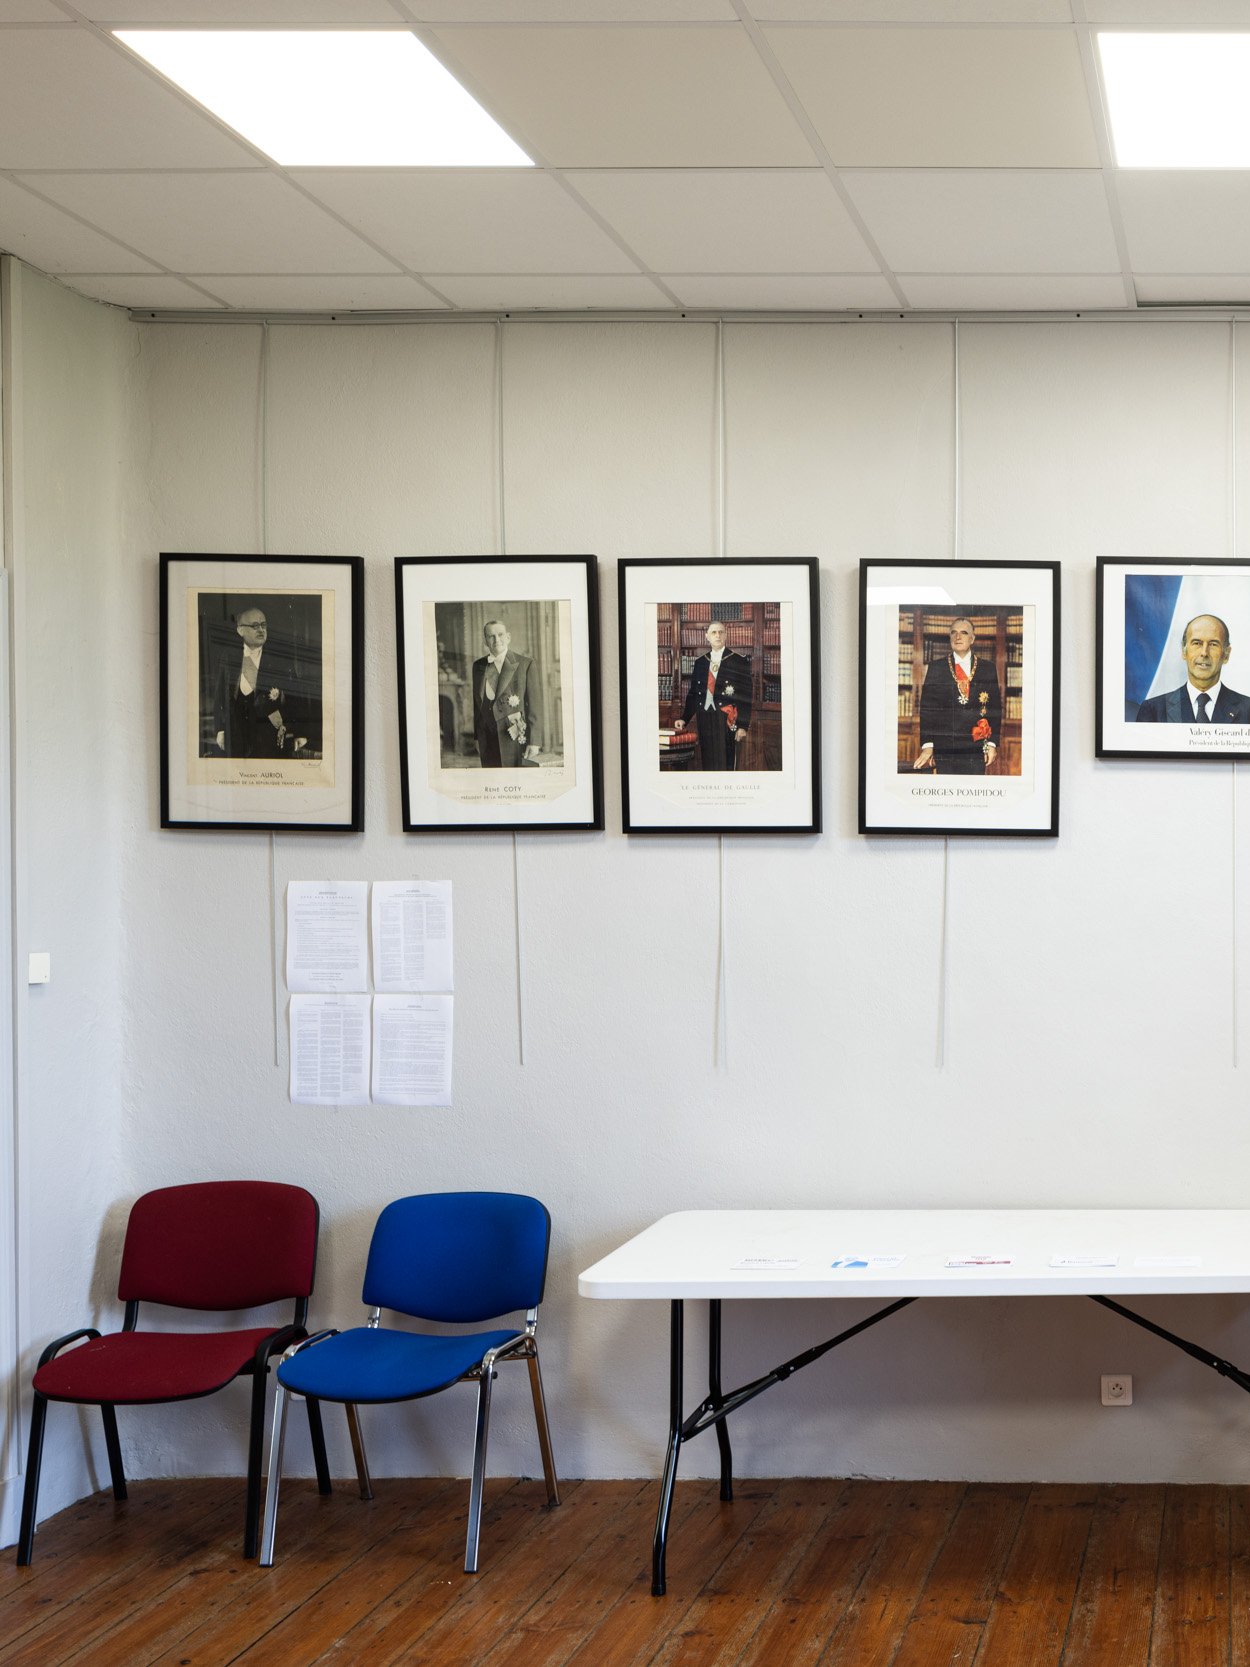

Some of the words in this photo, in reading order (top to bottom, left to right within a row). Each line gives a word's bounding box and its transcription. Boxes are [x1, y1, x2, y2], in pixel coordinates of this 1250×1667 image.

[1214, 727, 1243, 737] Giscard
[911, 787, 954, 796] GEORGES
[956, 788, 1007, 797] POMPIDOU
